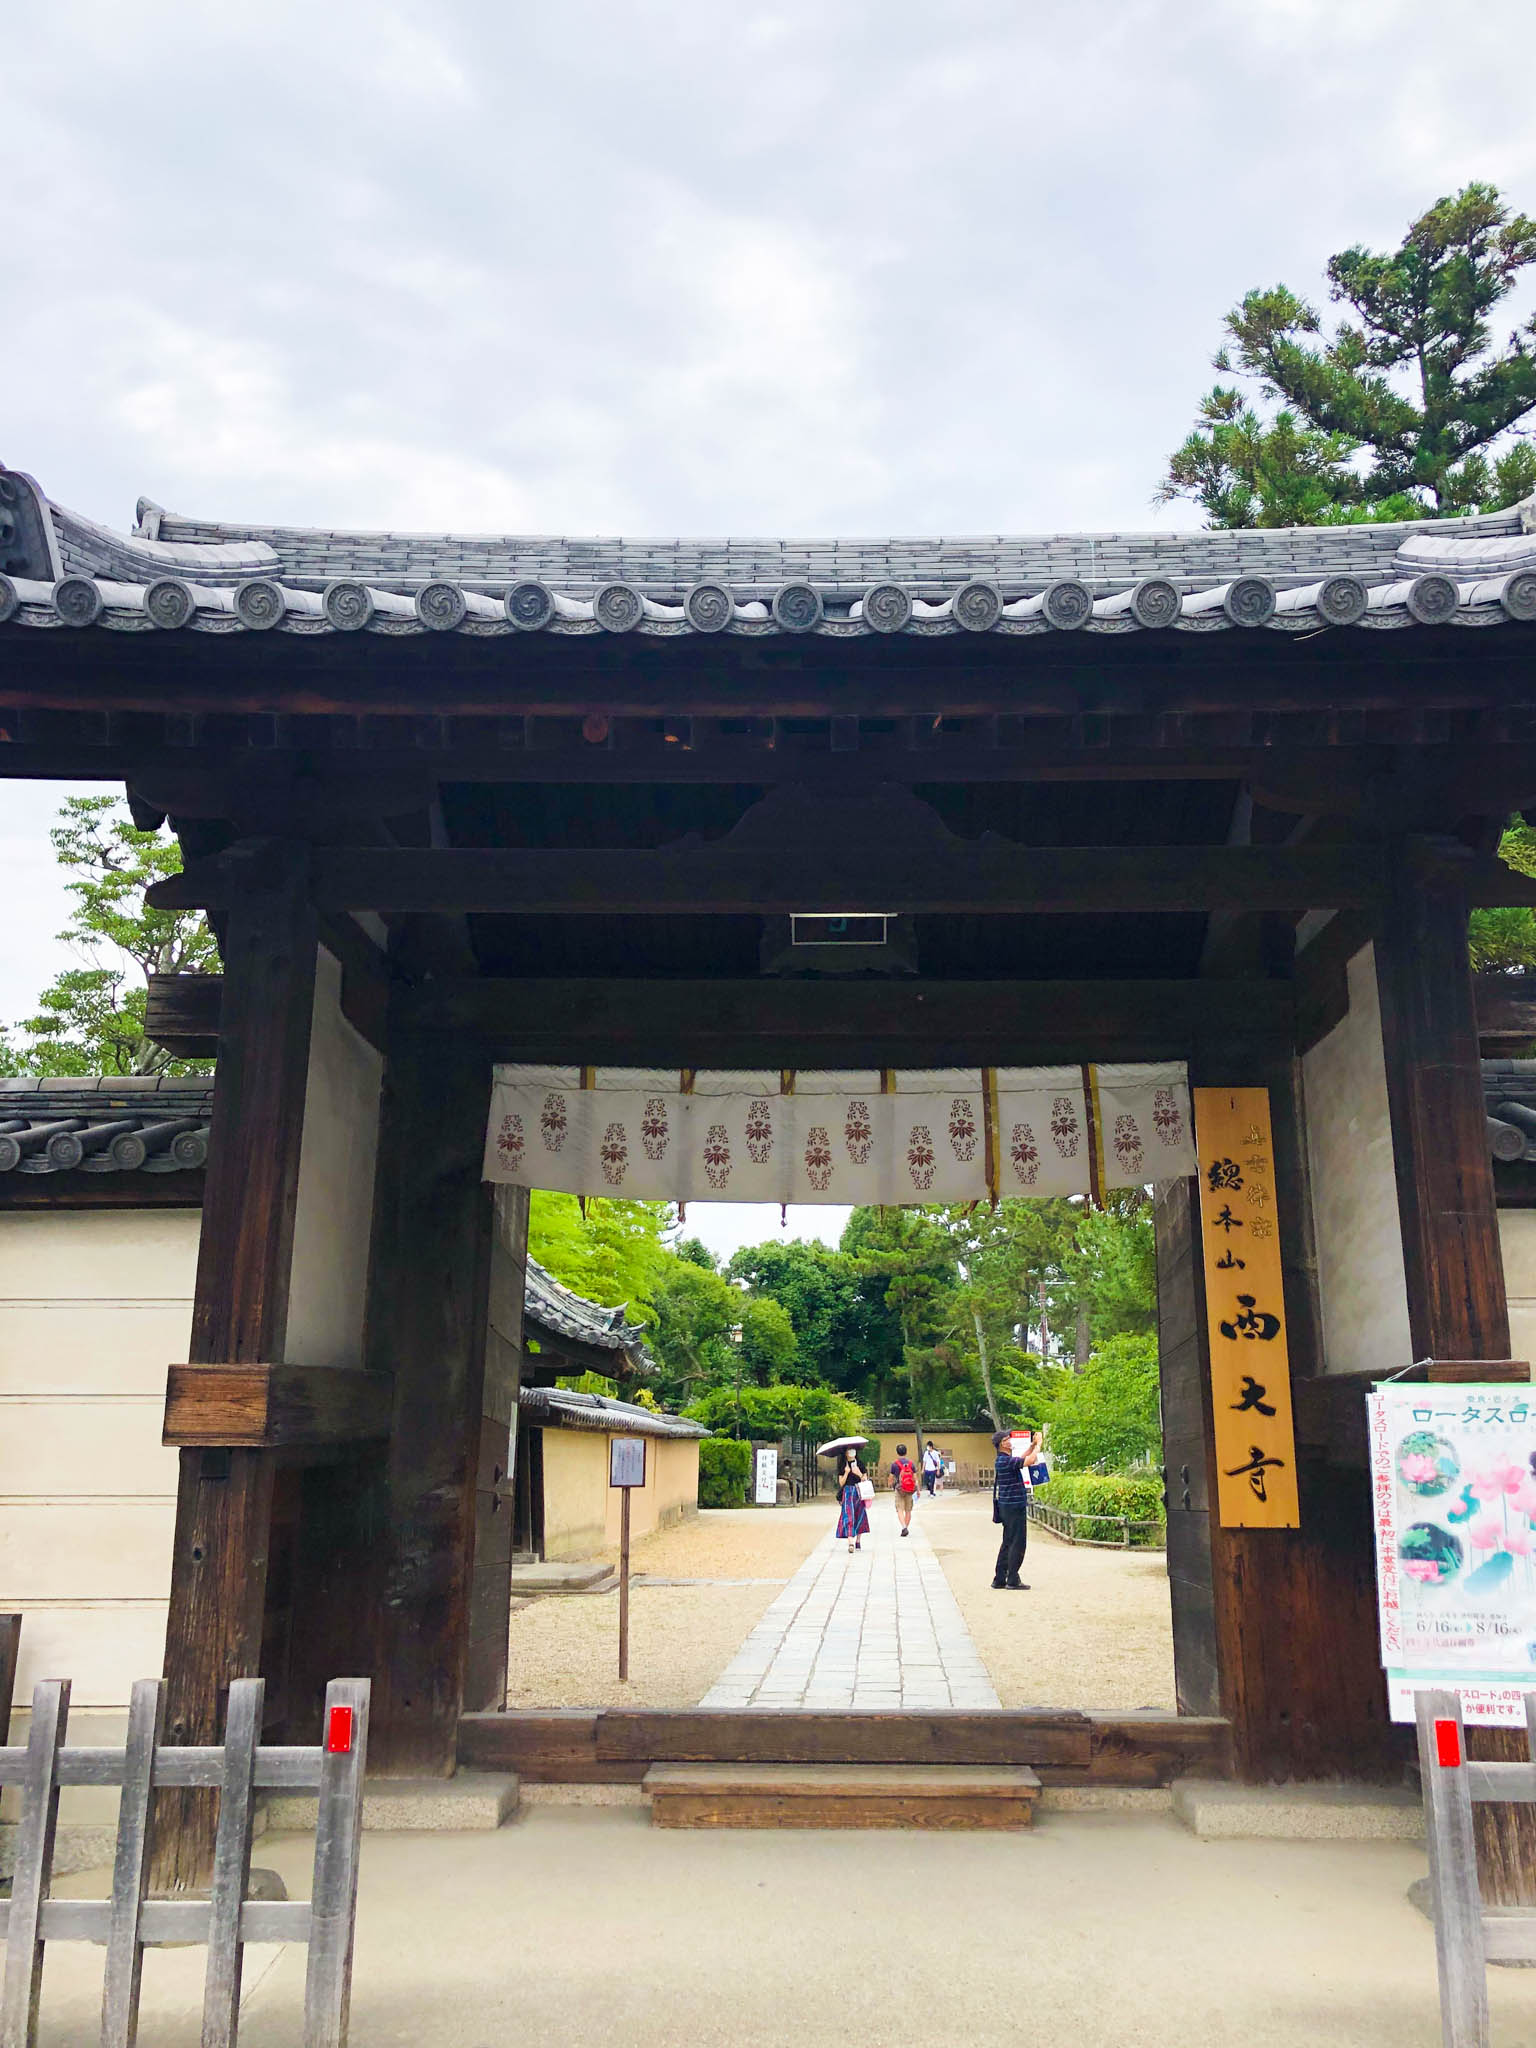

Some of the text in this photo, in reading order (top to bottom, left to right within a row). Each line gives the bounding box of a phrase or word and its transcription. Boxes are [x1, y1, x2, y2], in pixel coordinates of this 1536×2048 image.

[1412, 1406, 1536, 1424] ロータスロ
